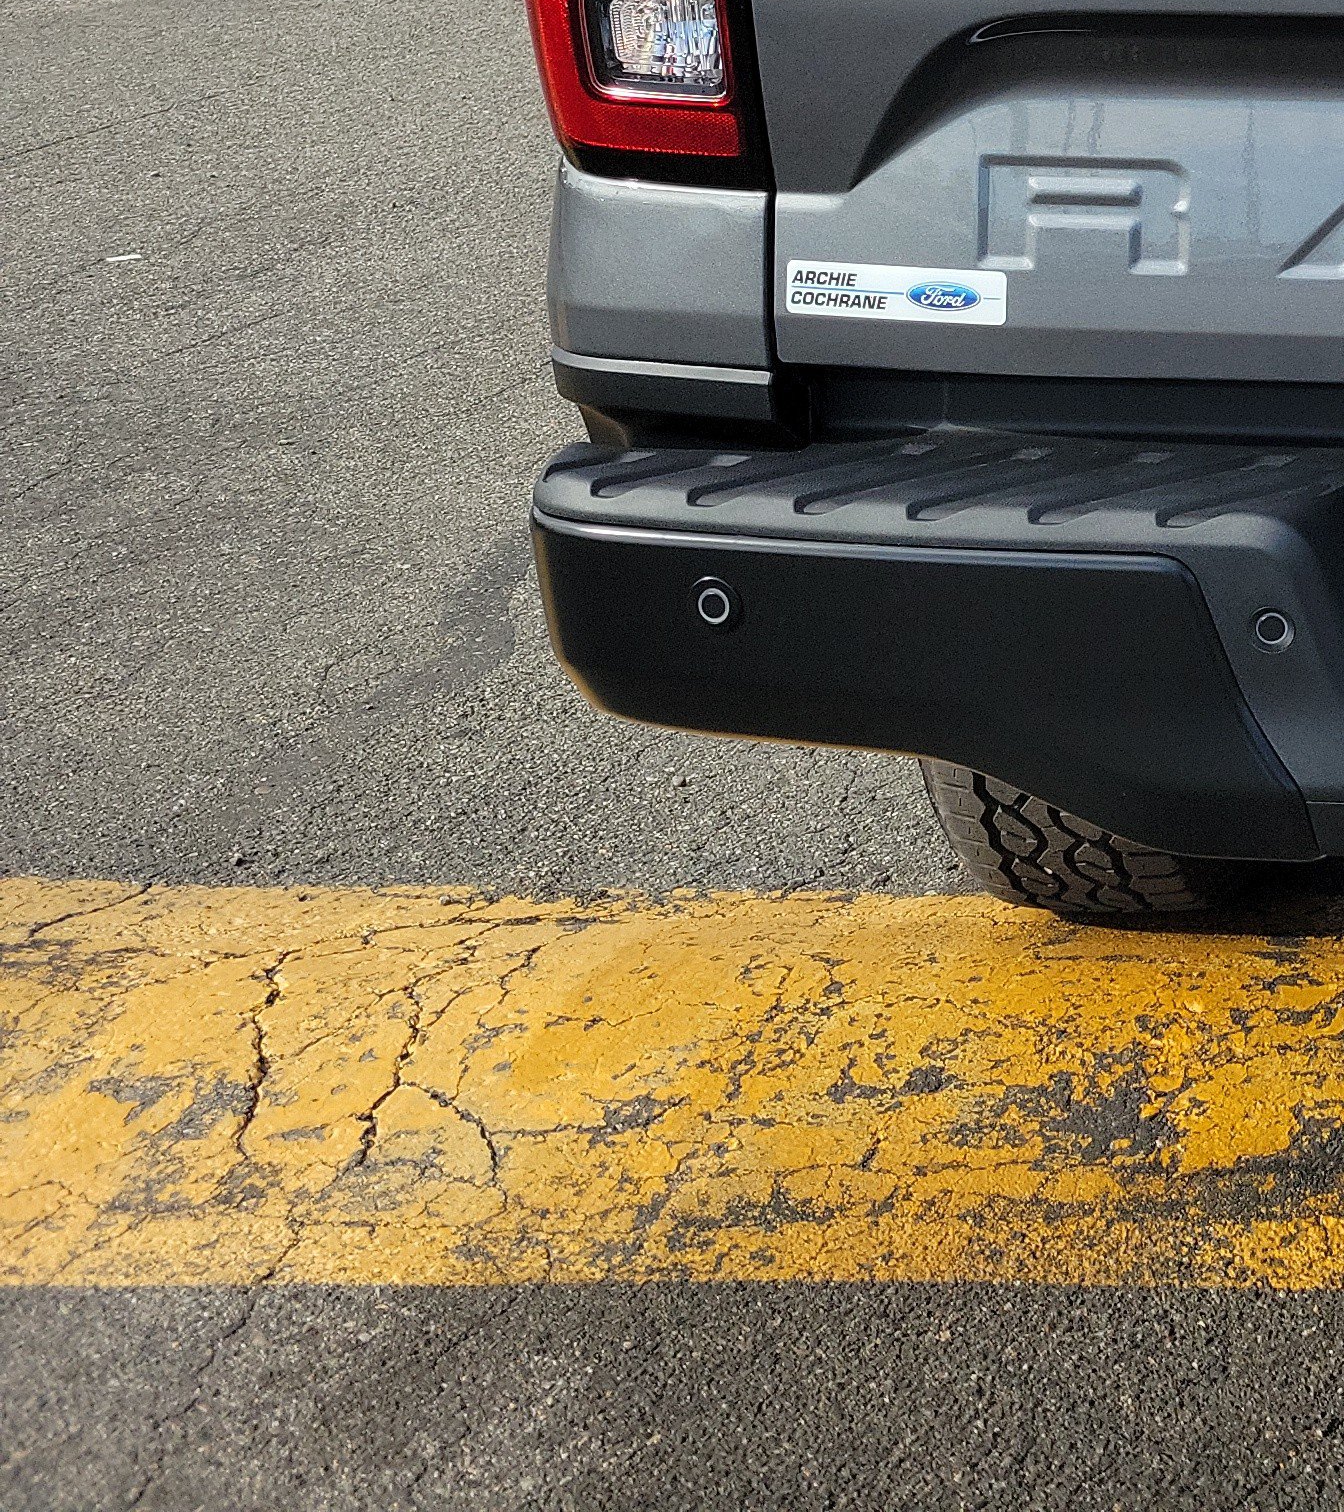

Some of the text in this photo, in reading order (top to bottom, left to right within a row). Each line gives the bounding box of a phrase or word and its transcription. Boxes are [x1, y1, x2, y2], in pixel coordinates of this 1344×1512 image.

[792, 270, 857, 287] ARCHIE
[791, 291, 888, 310] COCHRANE
[920, 285, 966, 308] Ford
